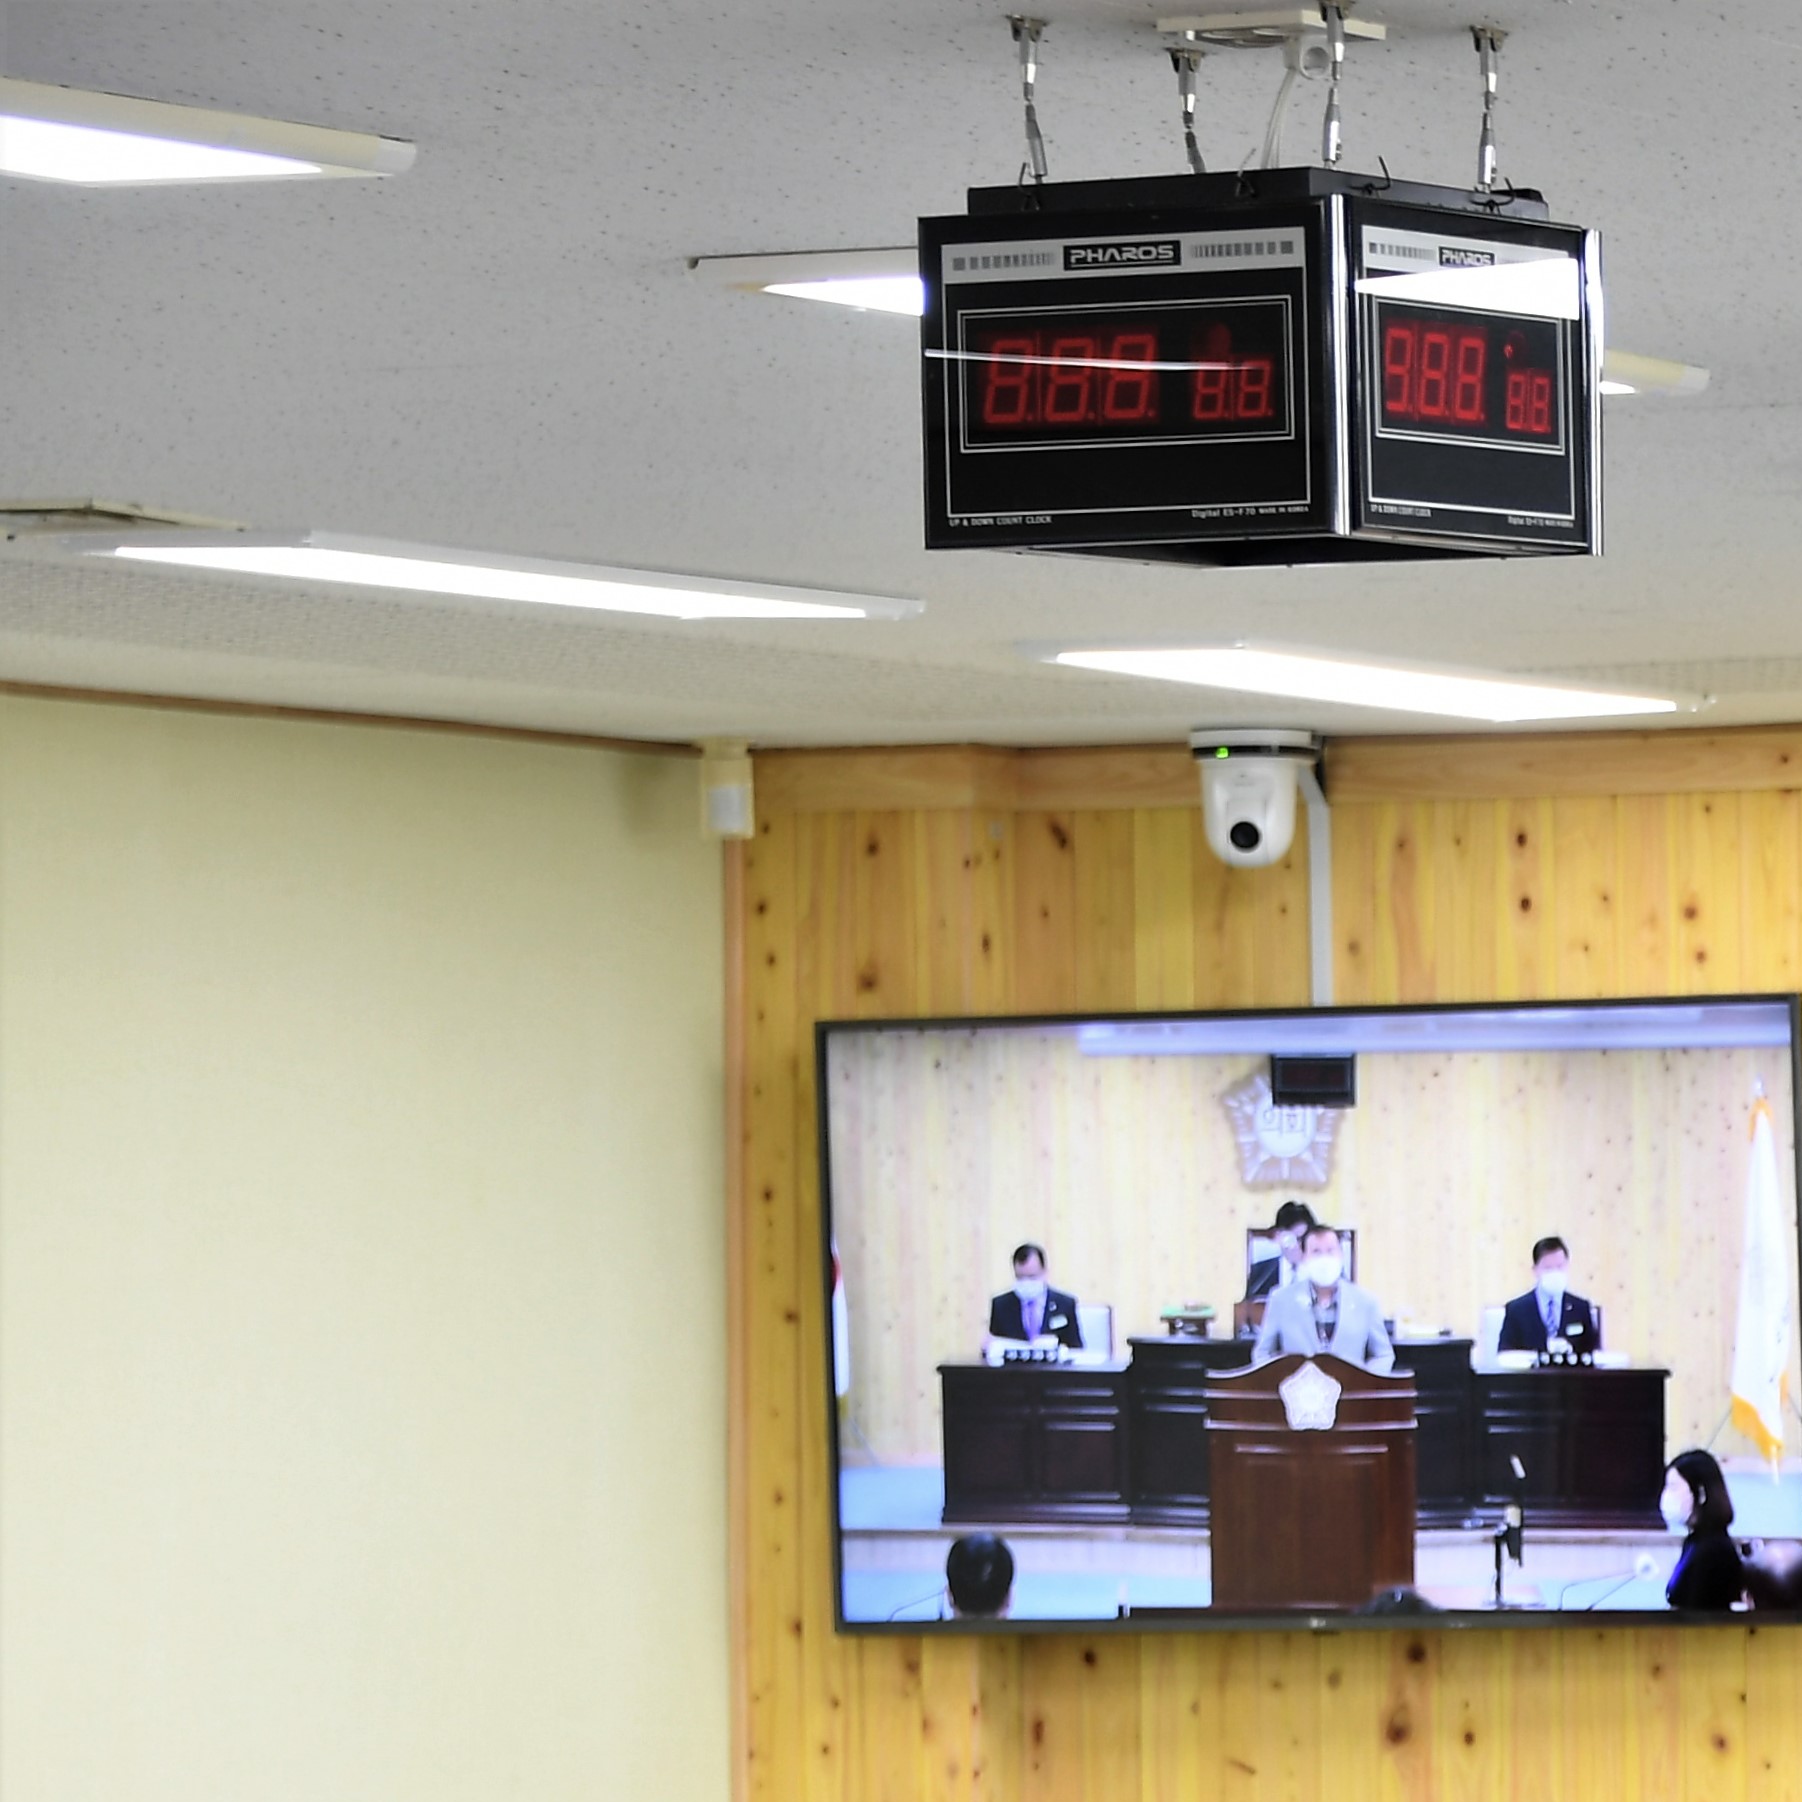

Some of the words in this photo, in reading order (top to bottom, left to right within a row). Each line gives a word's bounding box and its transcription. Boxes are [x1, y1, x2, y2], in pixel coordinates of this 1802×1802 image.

[1069, 244, 1175, 264] PHAROS
[1441, 249, 1492, 267] PHAROS
[971, 517, 994, 526] DOWN
[1025, 516, 1052, 525] CLOCK
